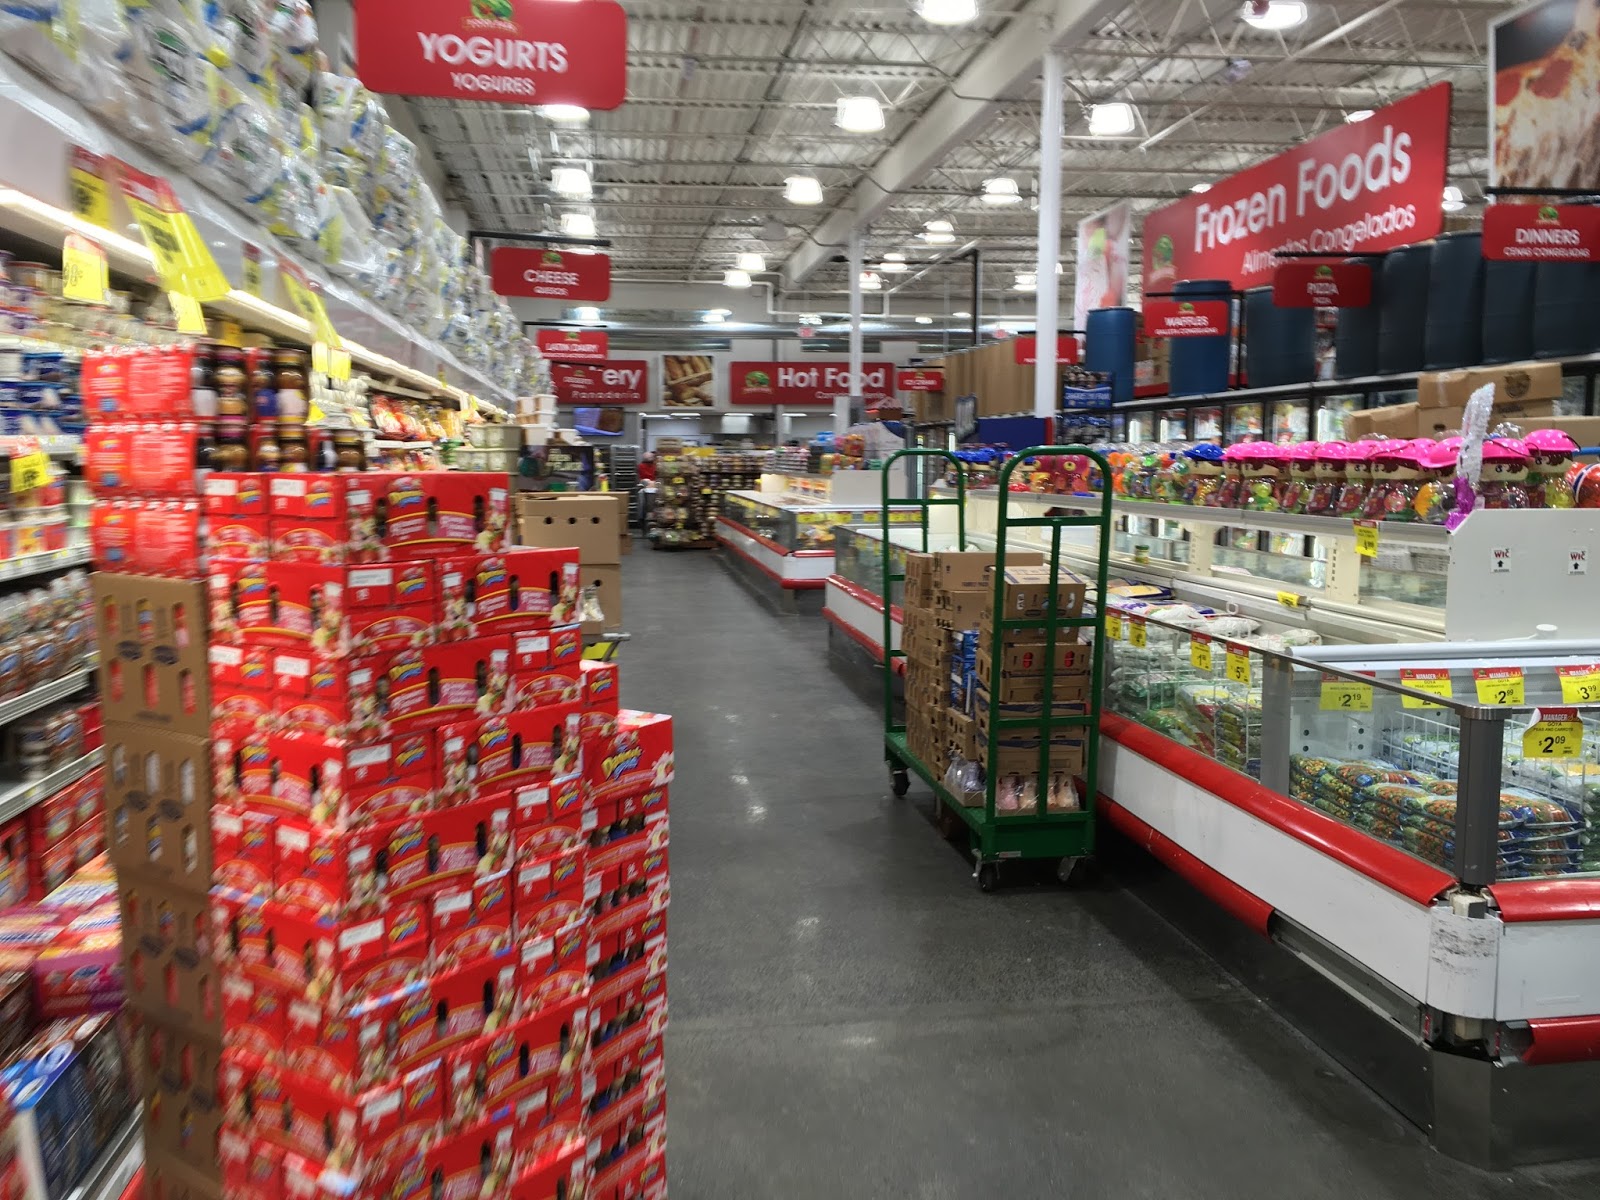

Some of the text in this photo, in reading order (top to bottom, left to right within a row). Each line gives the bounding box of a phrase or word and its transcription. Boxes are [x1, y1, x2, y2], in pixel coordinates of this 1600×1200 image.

[416, 31, 569, 74] YOGURTS
[450, 71, 537, 97] YOGURES
[1194, 124, 1412, 254] Frozen Foods
[1309, 204, 1417, 252] Congelados
[1515, 227, 1581, 245] DINNERS
[523, 268, 580, 286] CHEESE
[1306, 282, 1340, 295] PIZZA
[1164, 316, 1210, 327] WAFFLES
[777, 366, 819, 388] Hot
[1494, 550, 1509, 558] WIC
[1570, 552, 1585, 560] WIC
[1542, 713, 1568, 721] MANAGER
